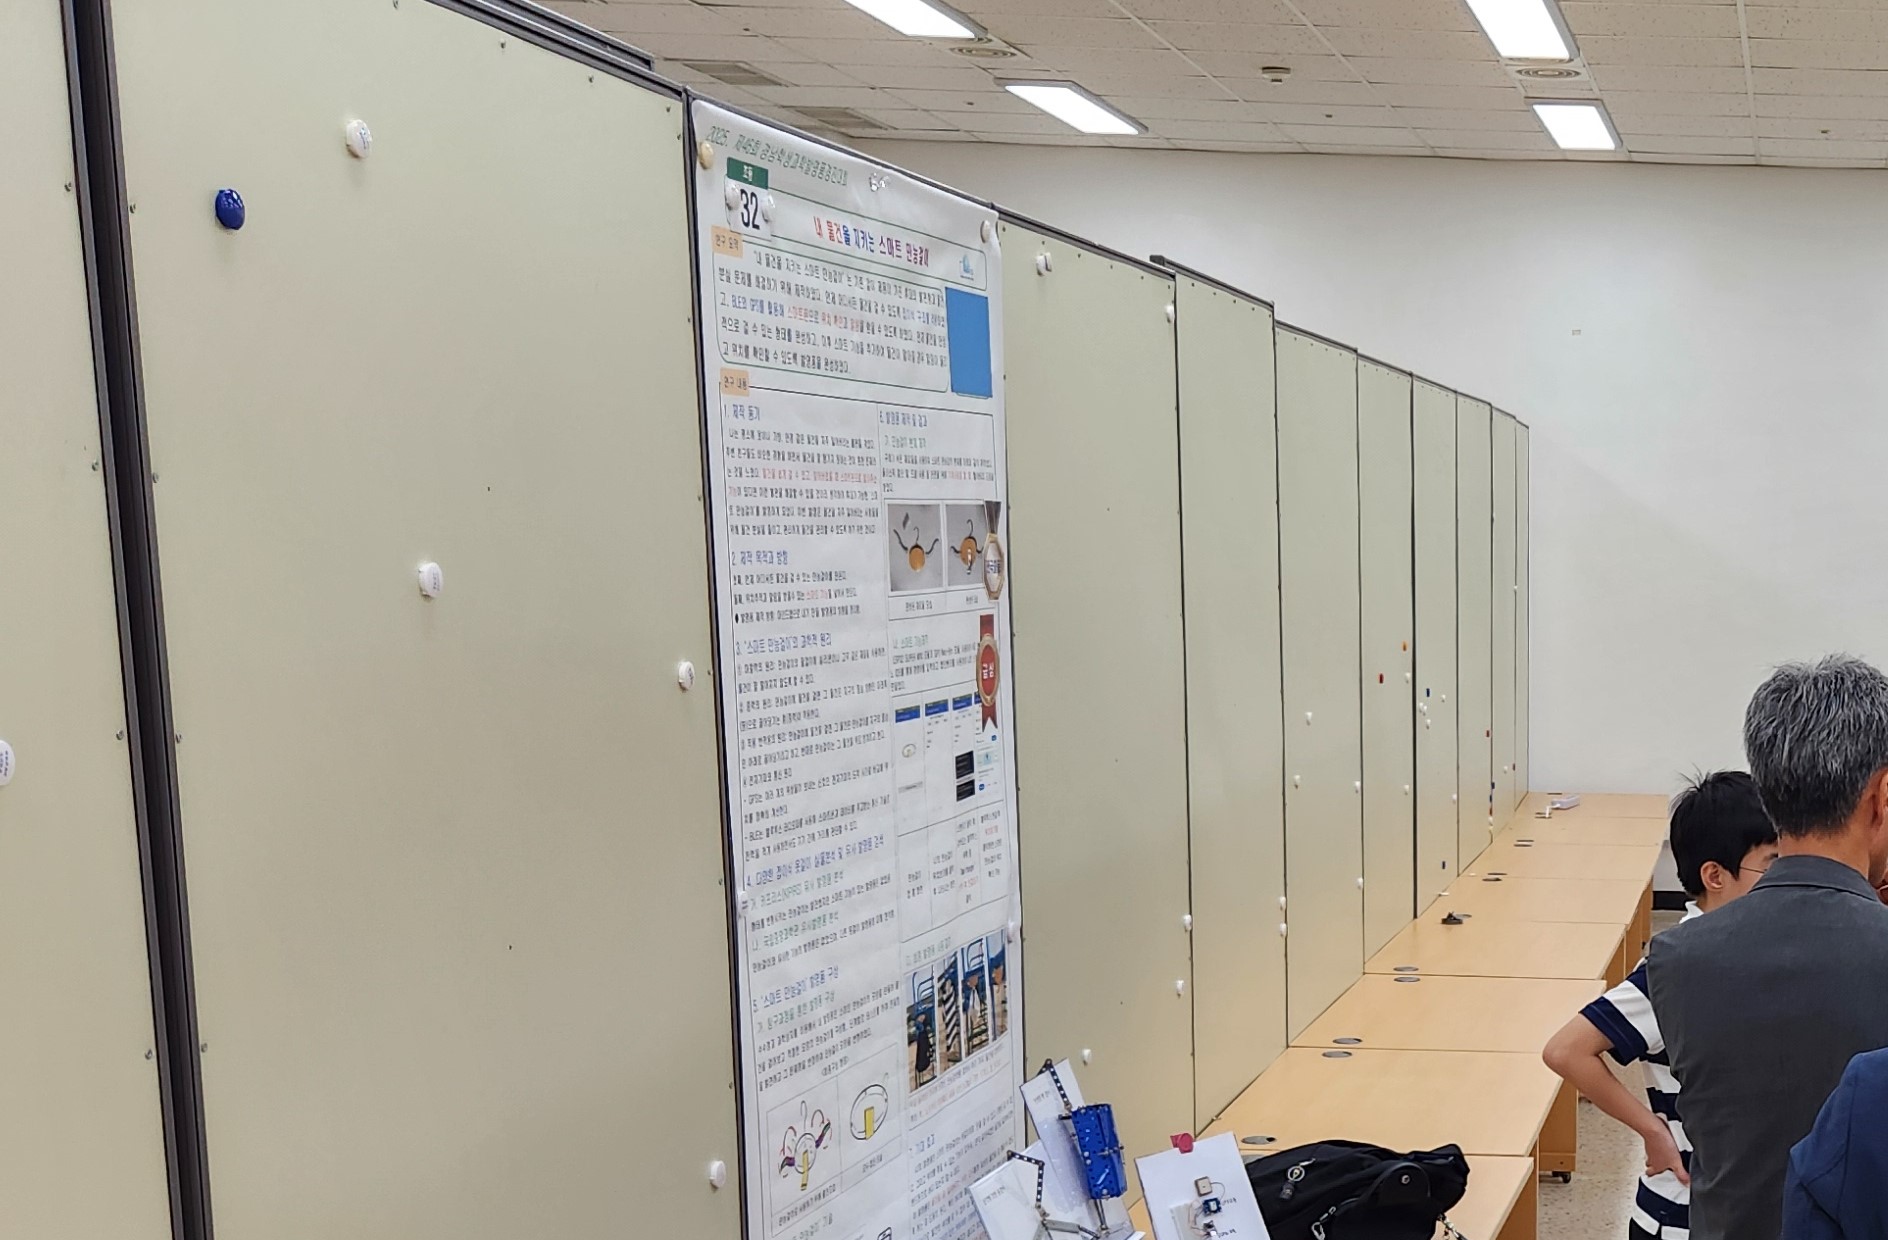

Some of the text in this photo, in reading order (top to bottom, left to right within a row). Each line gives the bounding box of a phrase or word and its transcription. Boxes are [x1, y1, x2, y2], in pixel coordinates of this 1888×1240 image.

[739, 186, 760, 232] 32
[826, 217, 851, 248] 물건을
[852, 225, 875, 254] 지키는
[877, 233, 902, 262] 스마트
[904, 241, 929, 270] 만능걸이
[731, 402, 746, 421] 제작
